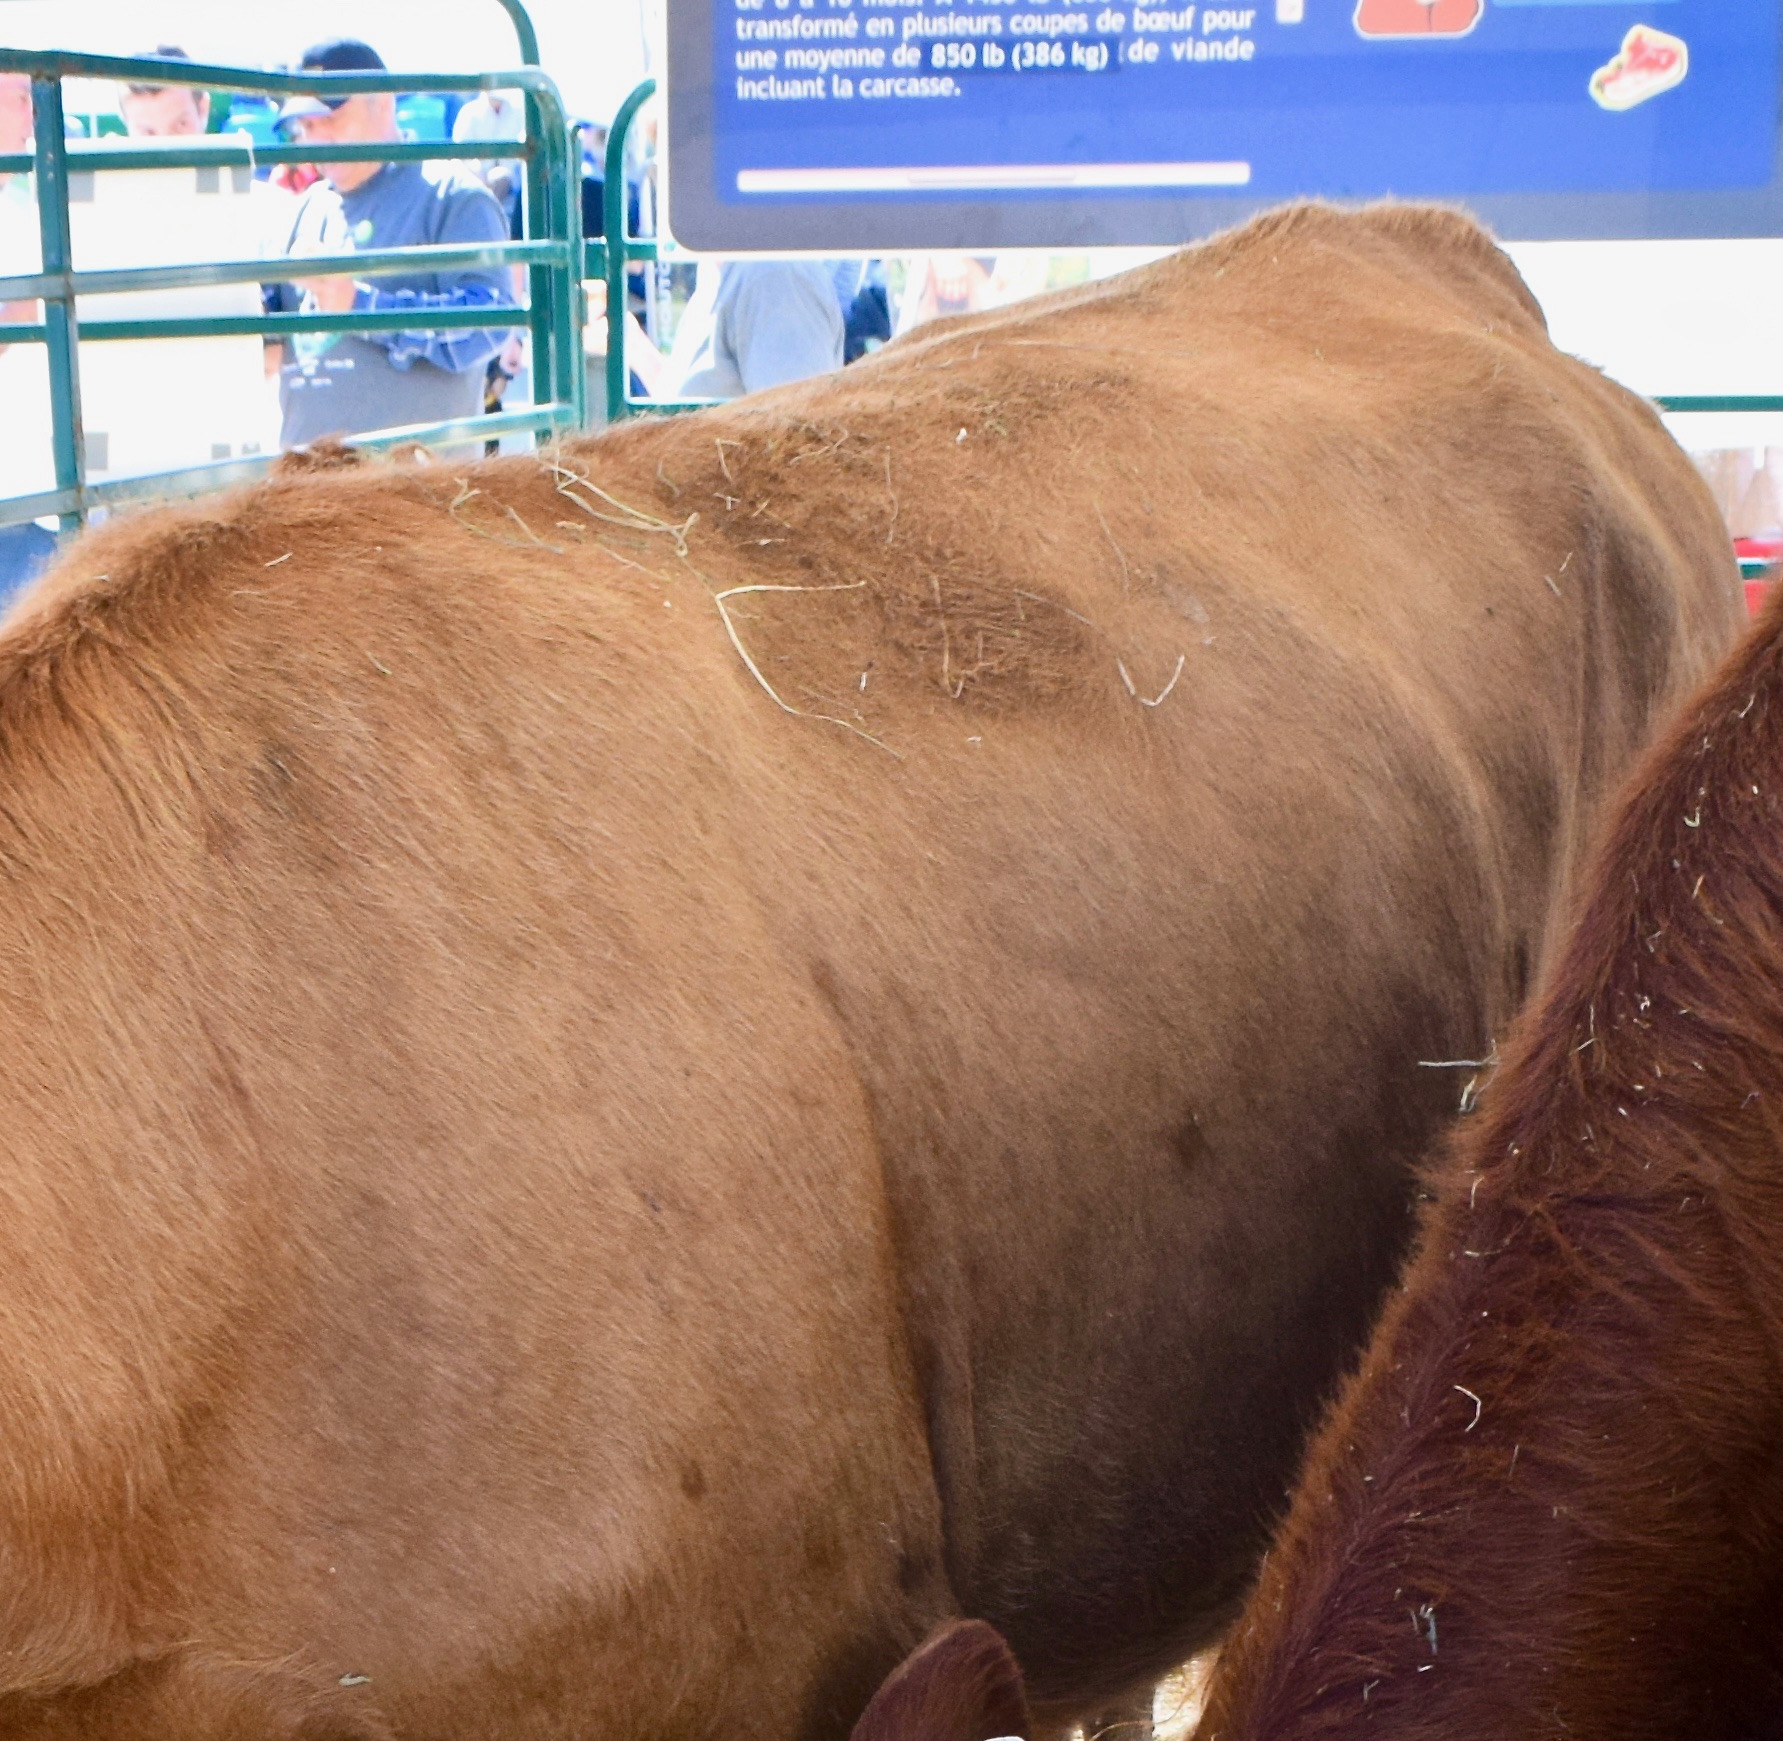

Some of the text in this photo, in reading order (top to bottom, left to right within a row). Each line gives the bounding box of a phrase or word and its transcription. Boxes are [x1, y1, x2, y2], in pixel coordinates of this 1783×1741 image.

[736, 5, 1256, 42] transformé en plusieurs coupes de bœuf pour
[736, 36, 1256, 74] une moyenne de 850 lb (386 kg) de viande
[737, 74, 961, 99] incluant la carcasse.
